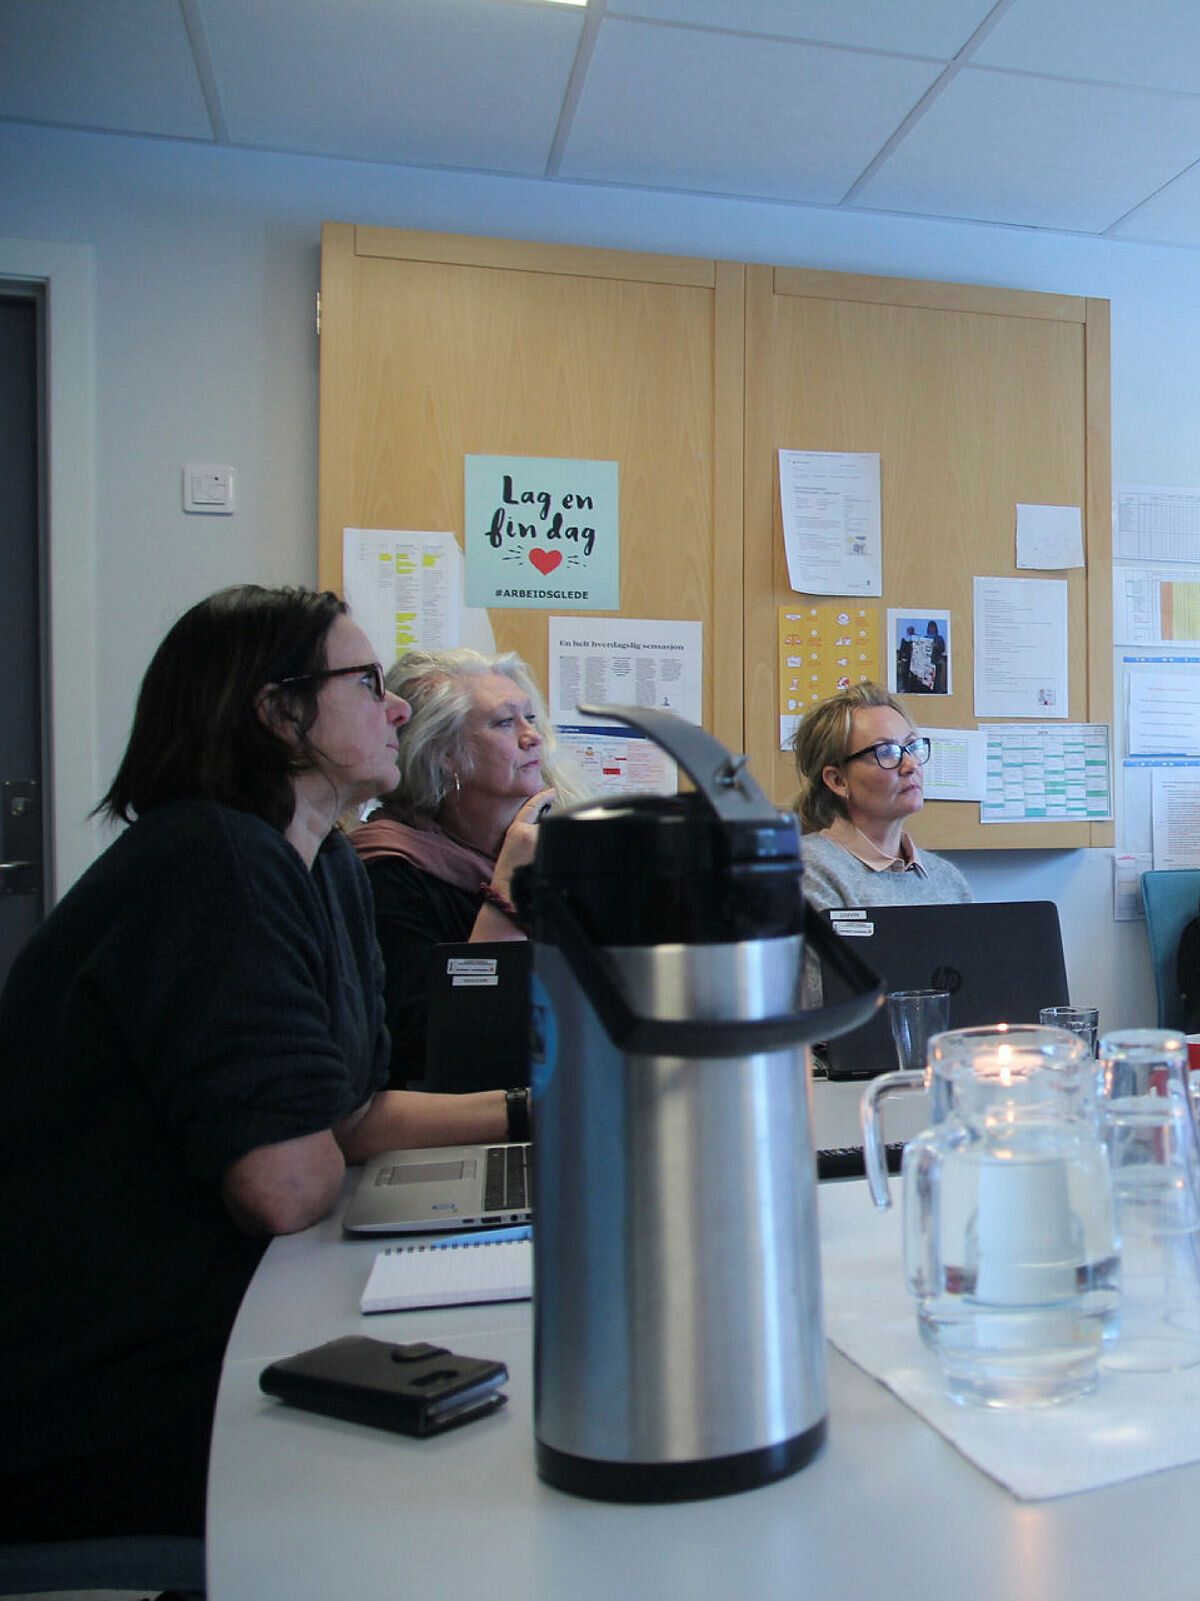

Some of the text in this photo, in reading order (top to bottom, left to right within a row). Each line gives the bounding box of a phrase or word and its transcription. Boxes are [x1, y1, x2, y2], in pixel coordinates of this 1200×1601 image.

[503, 475, 593, 520] Lag en
[484, 507, 596, 556] fin dag
[495, 589, 589, 600] #ARBEIDSGLEDE
[592, 640, 641, 650] hverdagslig
[643, 643, 684, 651] sensasjon
